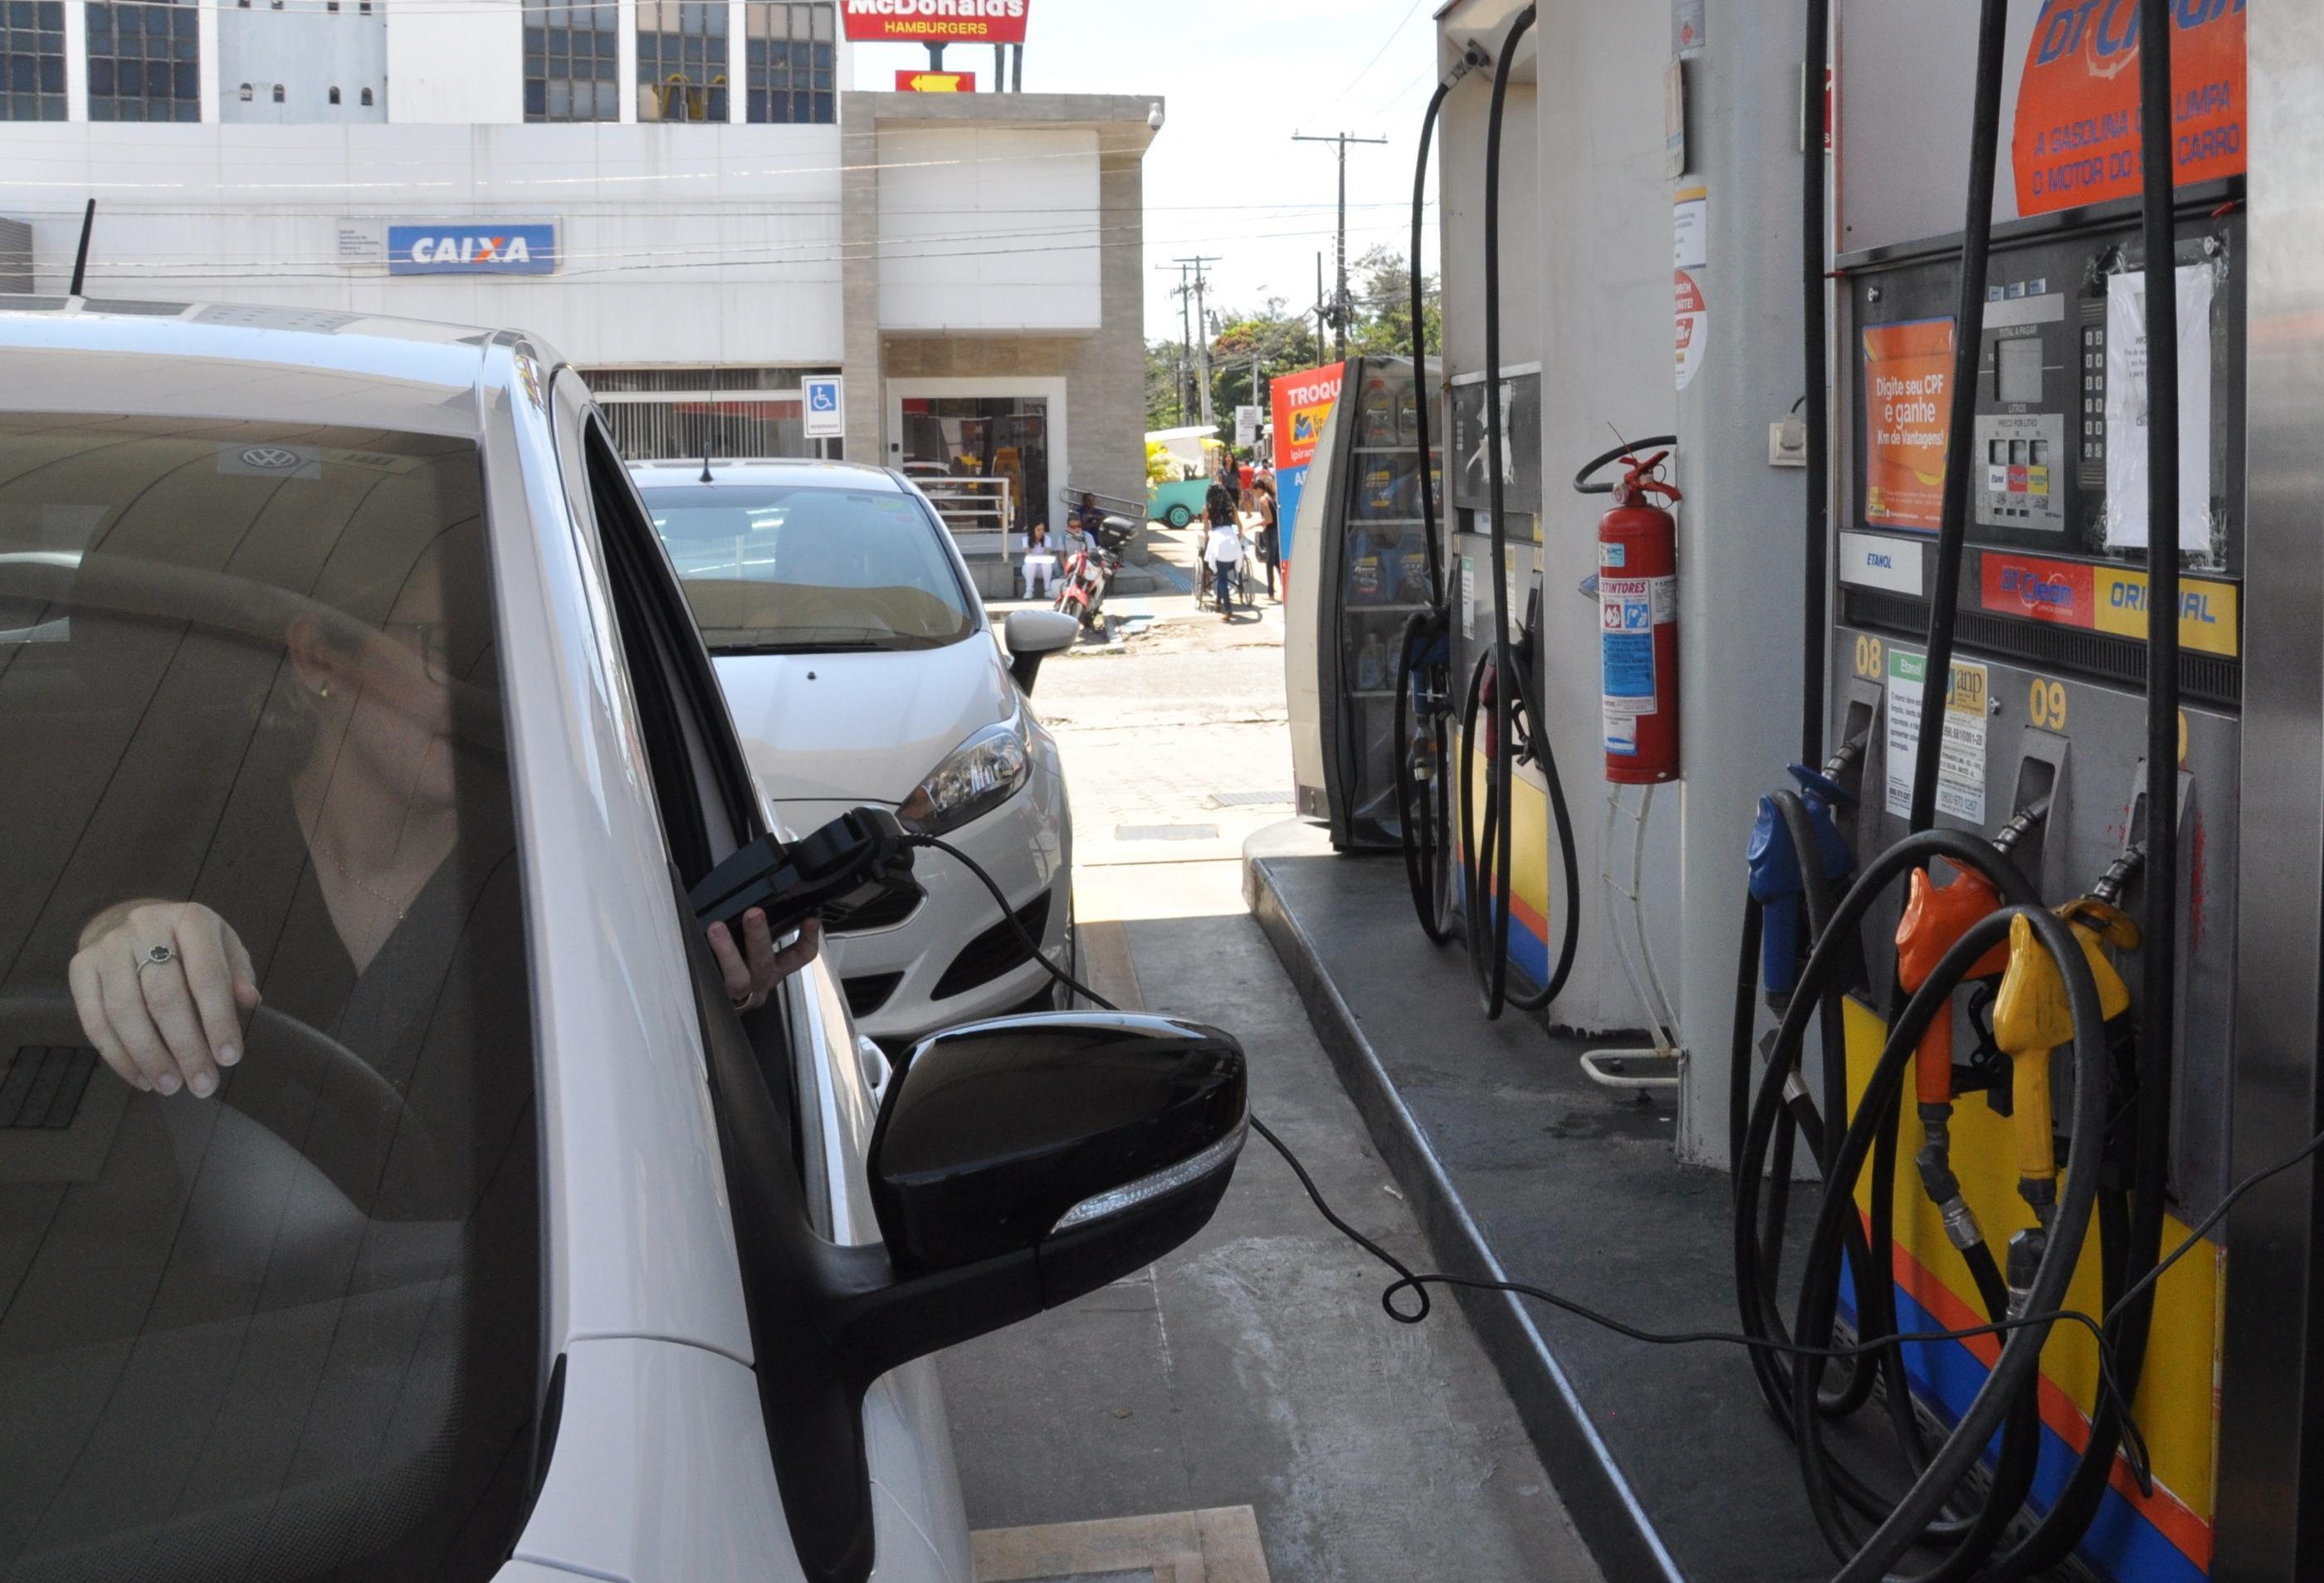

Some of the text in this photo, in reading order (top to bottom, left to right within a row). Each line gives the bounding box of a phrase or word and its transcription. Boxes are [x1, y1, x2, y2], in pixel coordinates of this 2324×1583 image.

[885, 21, 988, 35] HAMBURGERS
[2051, 110, 2129, 155] GASOLINA
[2175, 80, 2231, 122] LIMPA
[2048, 156, 2105, 192] MOTOR
[2109, 149, 2133, 181] DO
[2177, 124, 2239, 166] CARRO
[412, 236, 530, 264] CAIXA
[1287, 379, 1341, 407] TROQU
[1877, 374, 1944, 401] Digite seu CPF
[1885, 396, 1936, 430] e ganhe
[2009, 403, 2027, 413] LITROS
[1877, 428, 1944, 450] Km de Vantagens!
[1290, 448, 1315, 463] Ipiran
[1867, 552, 1892, 569] ETANOL
[2021, 572, 2073, 607] Clean
[2111, 581, 2216, 623] ORIAL
[1856, 635, 1882, 678] 08
[1901, 658, 1922, 676] Etanol
[1956, 669, 1982, 702] anp
[2029, 677, 2067, 730] 09
